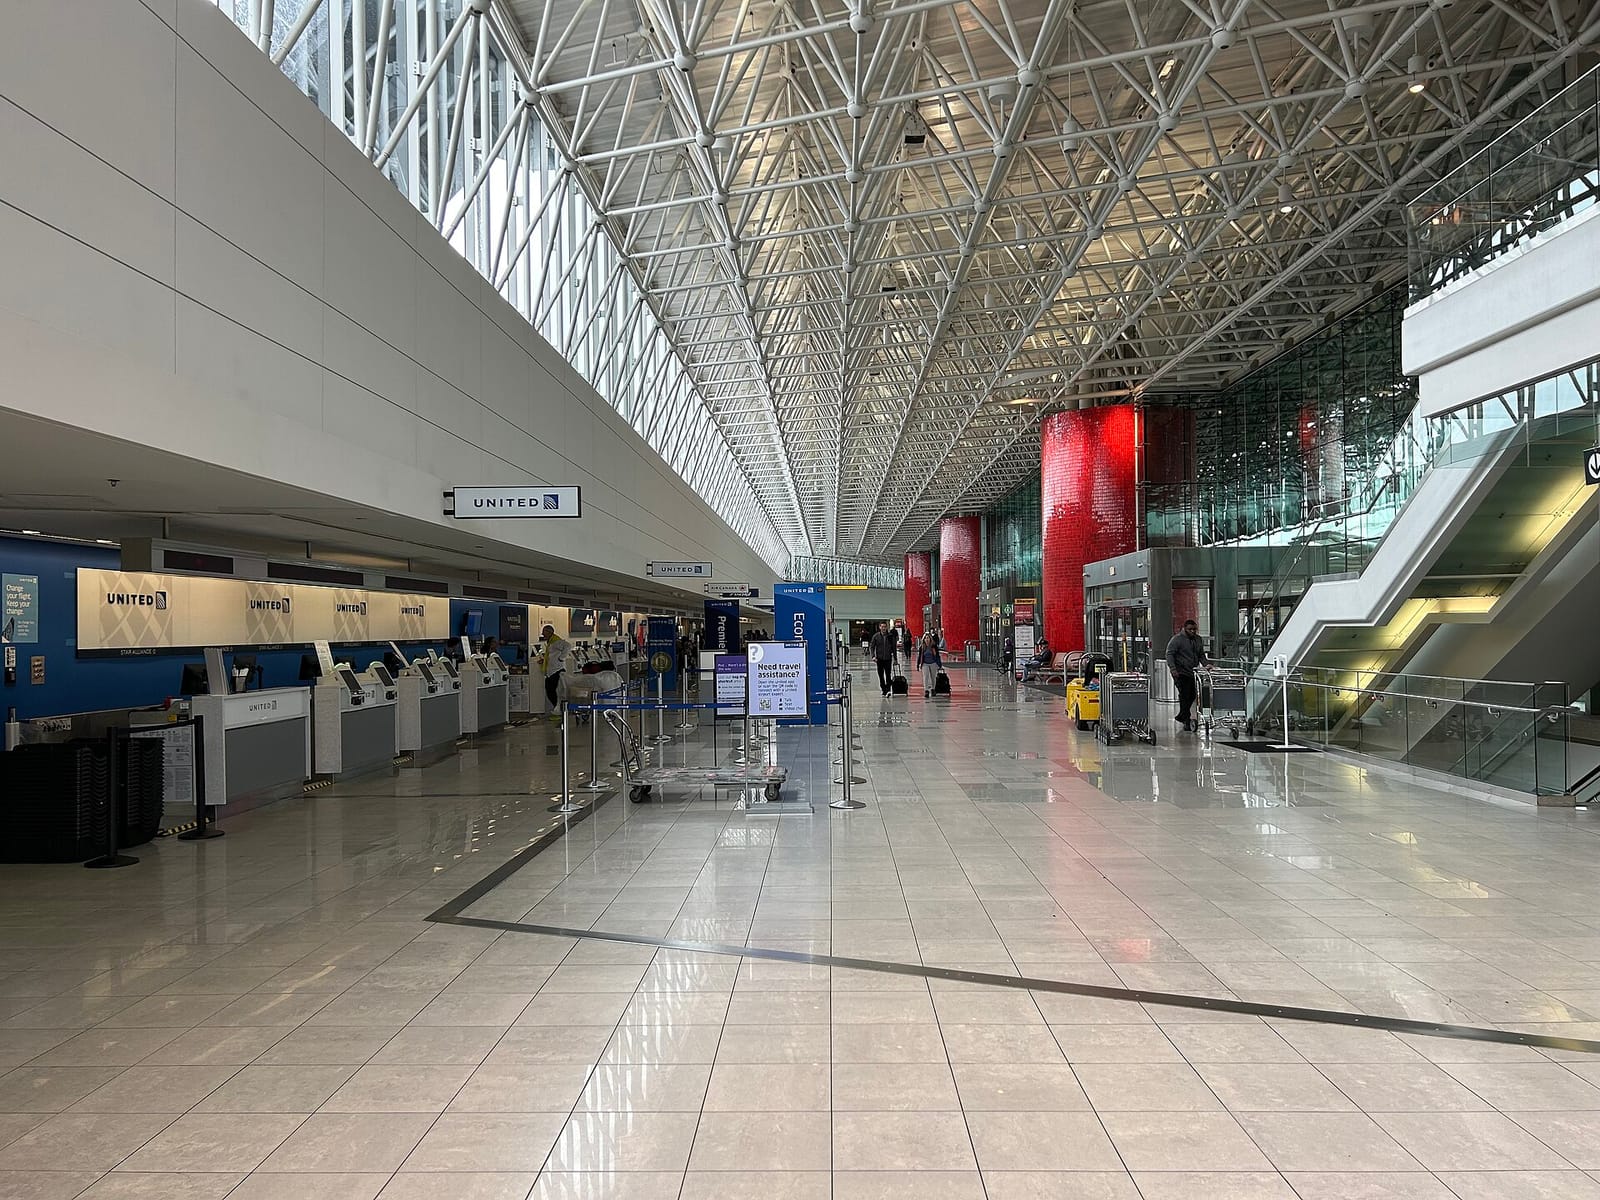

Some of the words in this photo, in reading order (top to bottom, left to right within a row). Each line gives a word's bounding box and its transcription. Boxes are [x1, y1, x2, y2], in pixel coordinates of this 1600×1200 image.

[473, 498, 539, 508] UNITED
[6, 600, 18, 608] Keep
[107, 593, 154, 606] UNITED
[250, 599, 281, 610] UNITED
[336, 604, 360, 613] UNITED
[401, 607, 419, 615] UNITED
[249, 702, 271, 711] UNITED
